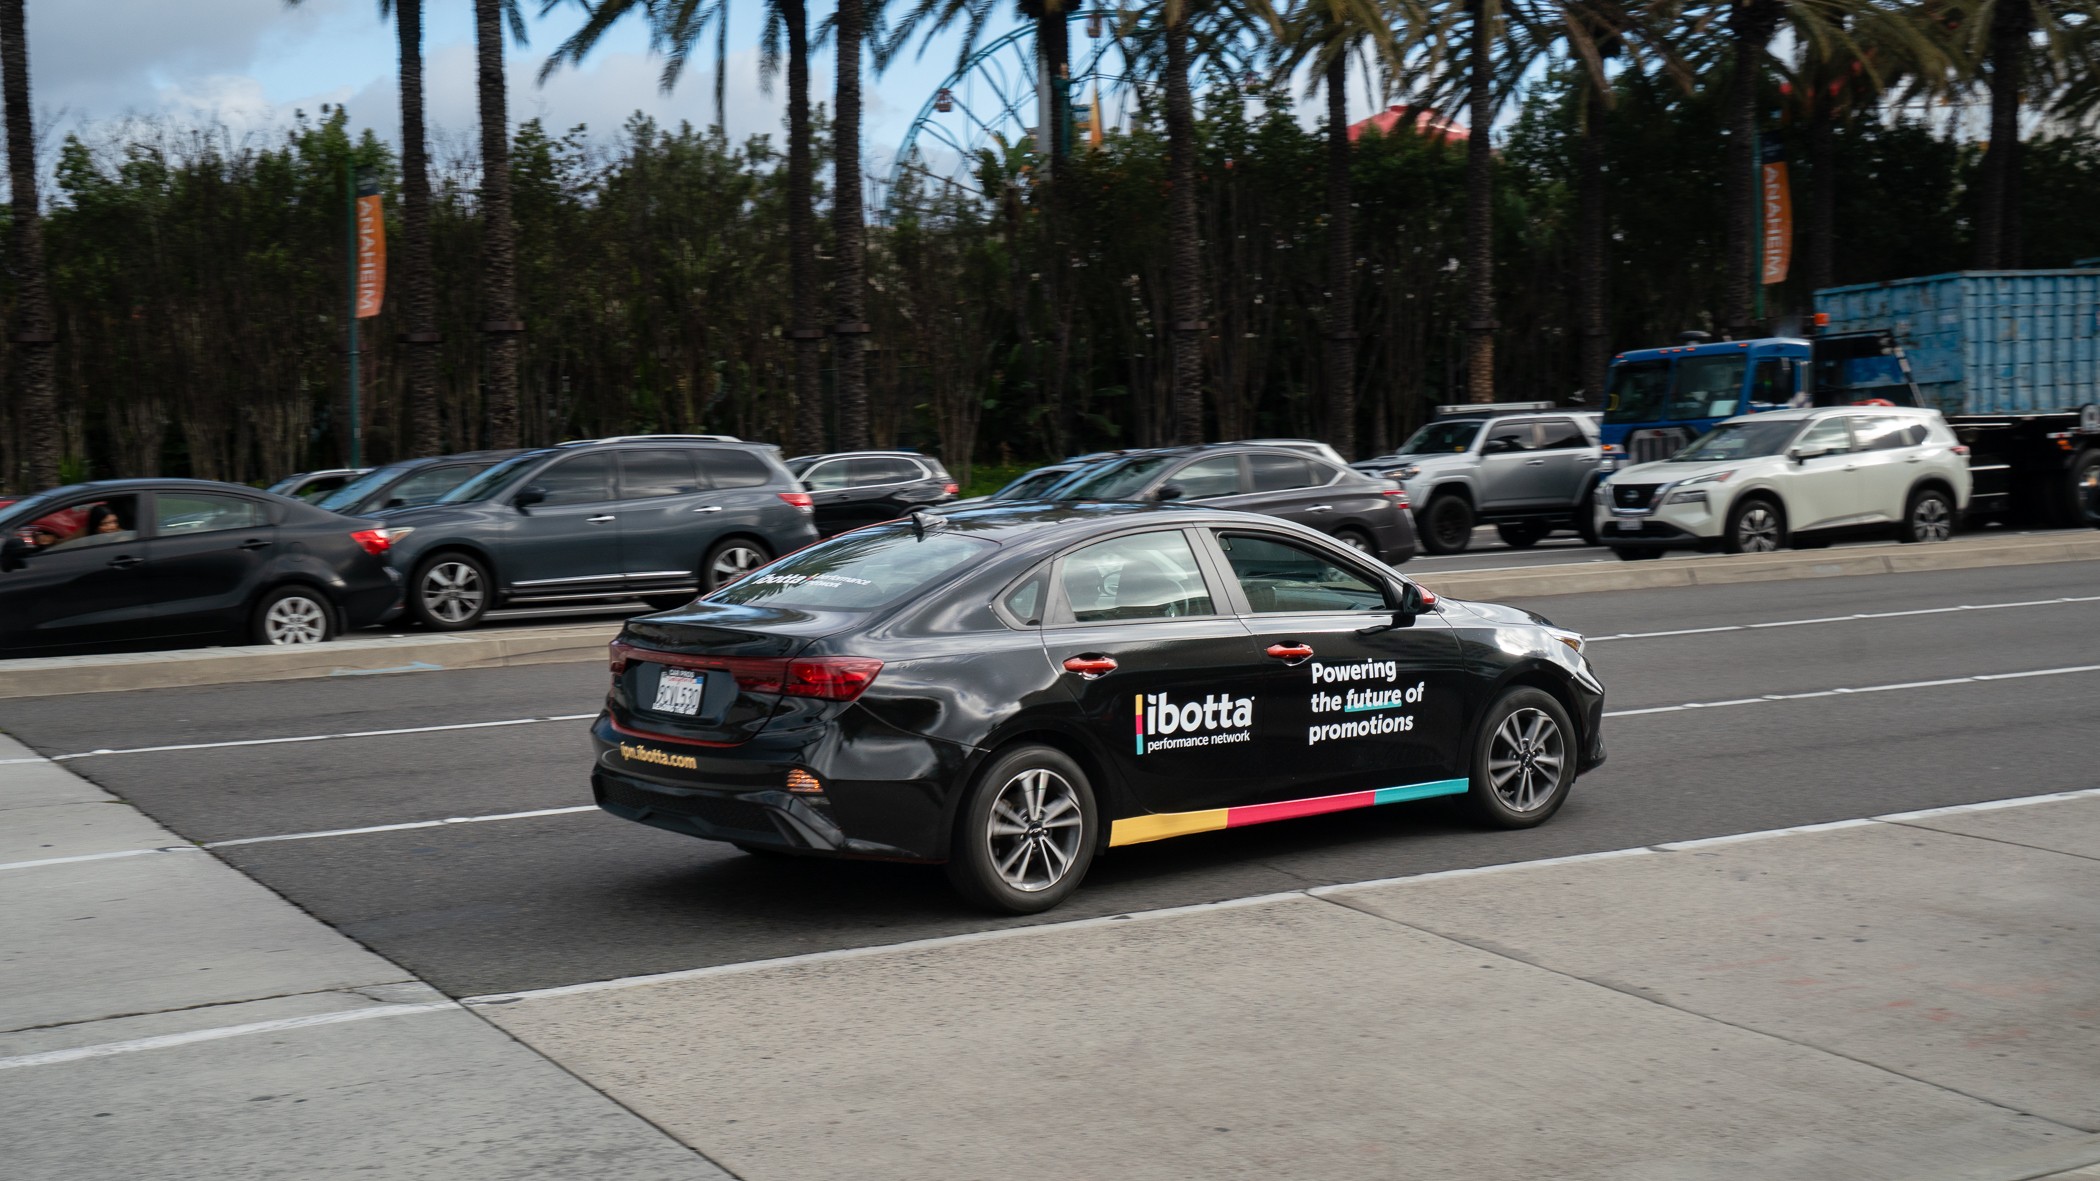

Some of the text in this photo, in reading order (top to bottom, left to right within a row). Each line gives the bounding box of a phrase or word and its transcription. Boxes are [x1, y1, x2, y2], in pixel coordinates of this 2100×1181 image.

[1765, 167, 1783, 275] ANAHEIM
[359, 201, 376, 309] ANAHEIM
[751, 573, 807, 585] ibotta
[1311, 658, 1397, 684] Powering
[1310, 681, 1425, 713] the future of
[1147, 692, 1253, 735] ibotta
[1147, 730, 1251, 754] performance network
[1308, 714, 1414, 746] promotions
[620, 741, 698, 770] ipn.ibotta.com
